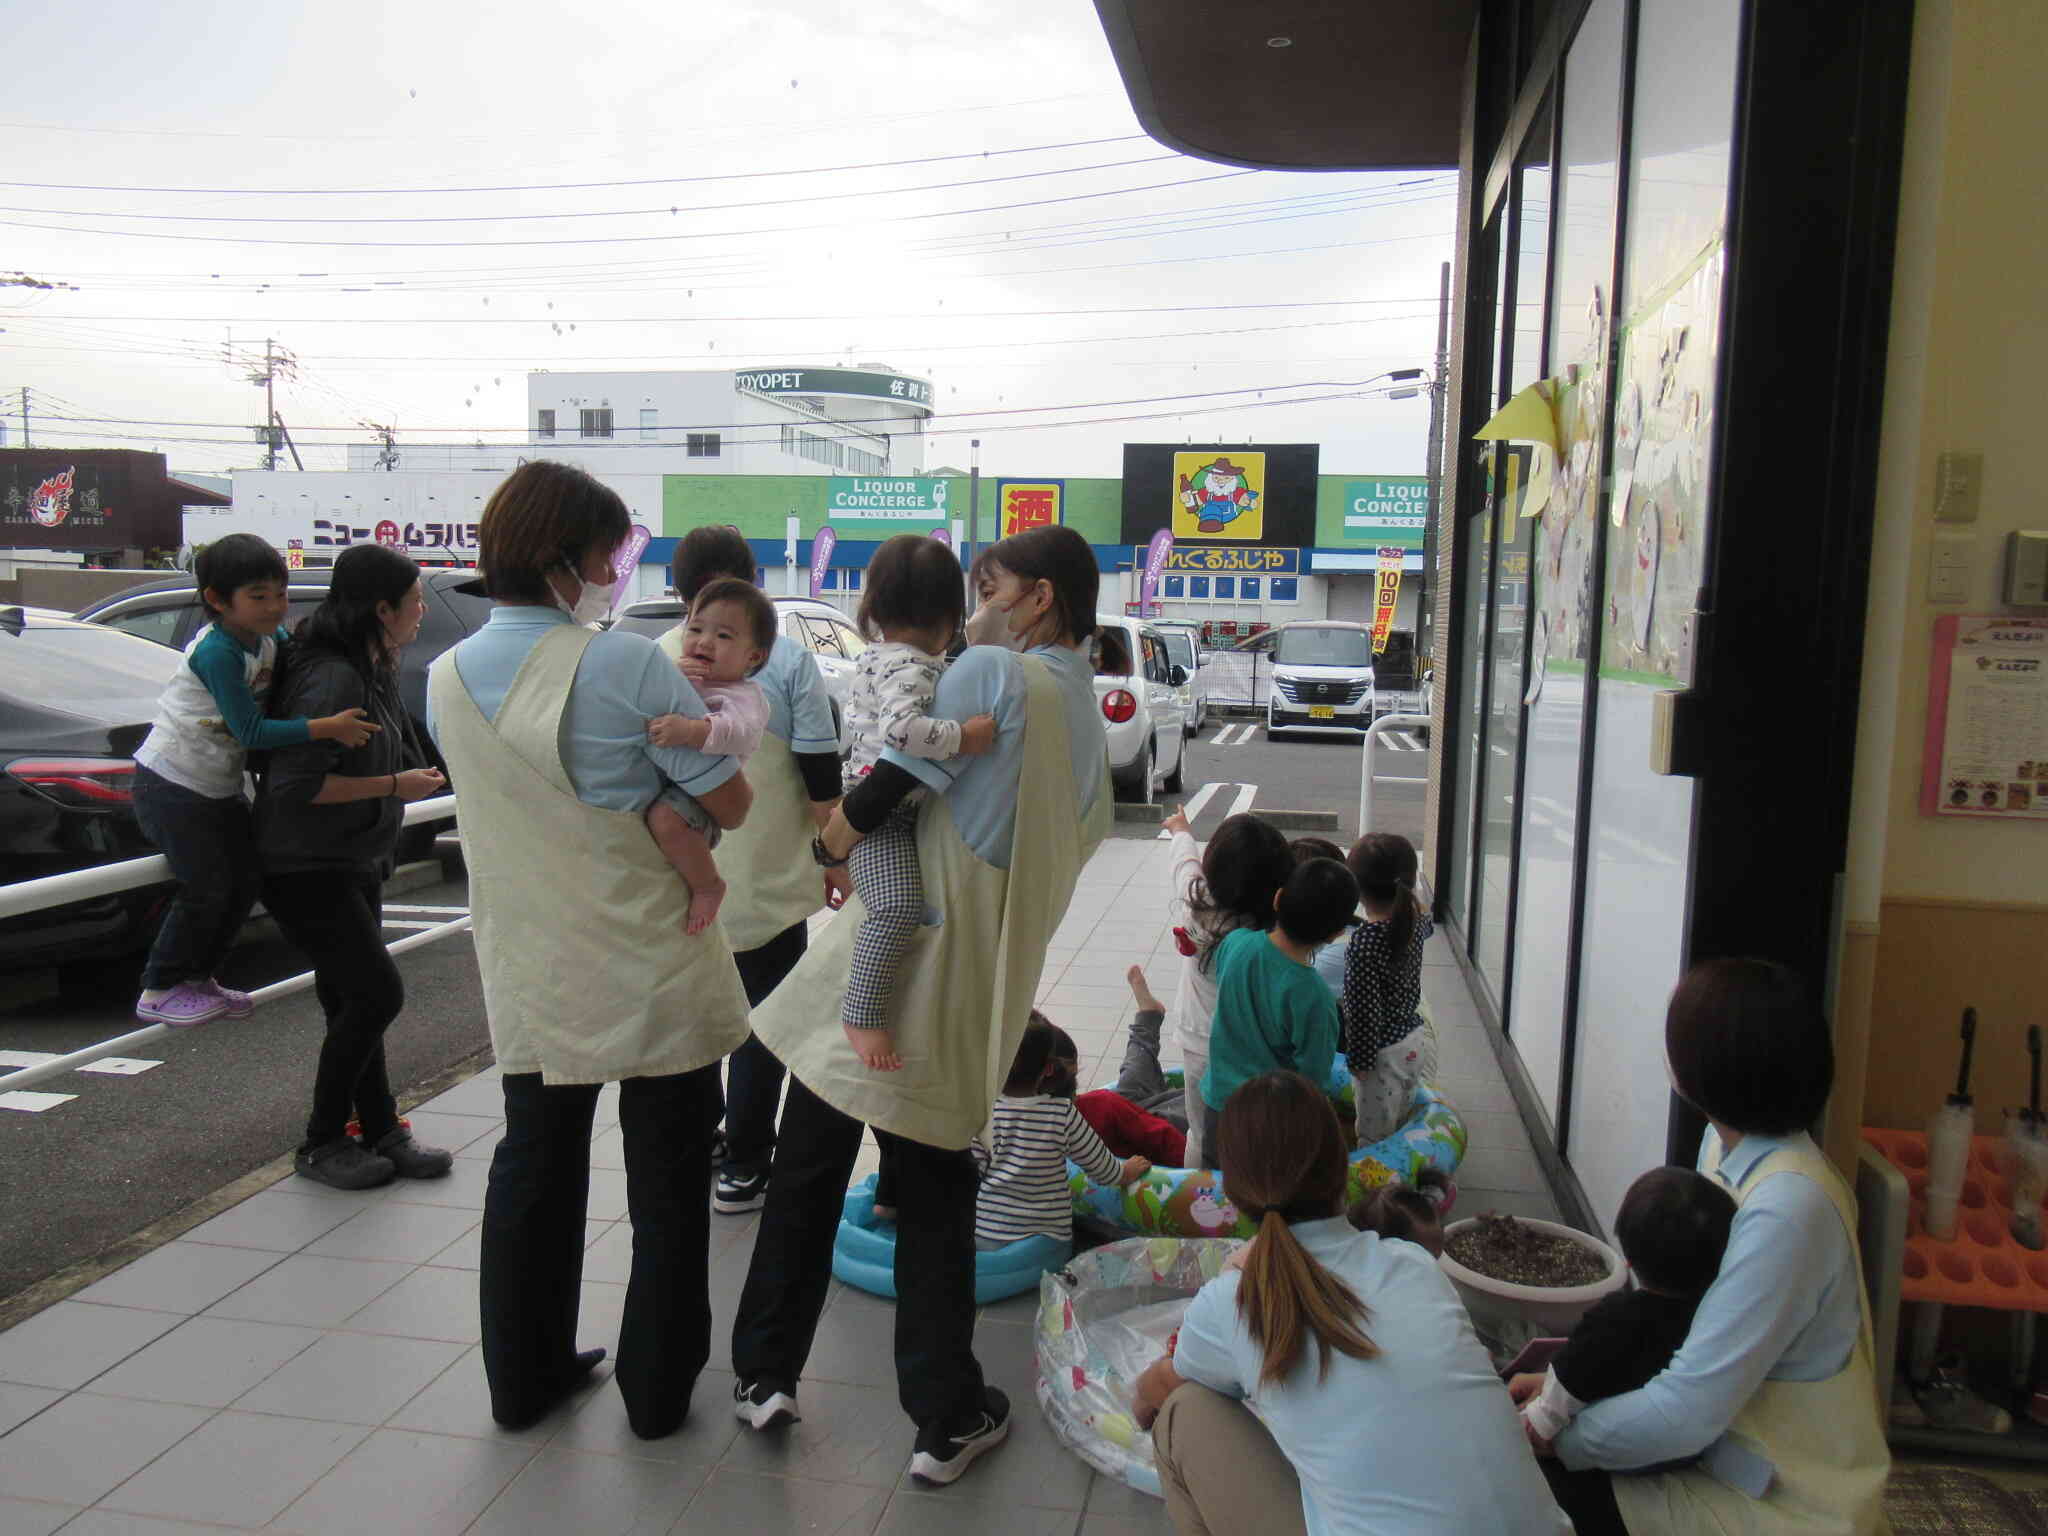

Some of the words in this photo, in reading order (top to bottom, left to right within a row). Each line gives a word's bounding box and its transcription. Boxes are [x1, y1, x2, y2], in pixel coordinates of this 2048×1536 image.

[853, 479, 917, 495] LIQUOR
[835, 492, 927, 507] CONCIERGE
[1353, 497, 1428, 514] CONCIE
[1006, 490, 1054, 535] 酒
[1163, 549, 1285, 570] んくるふじや
